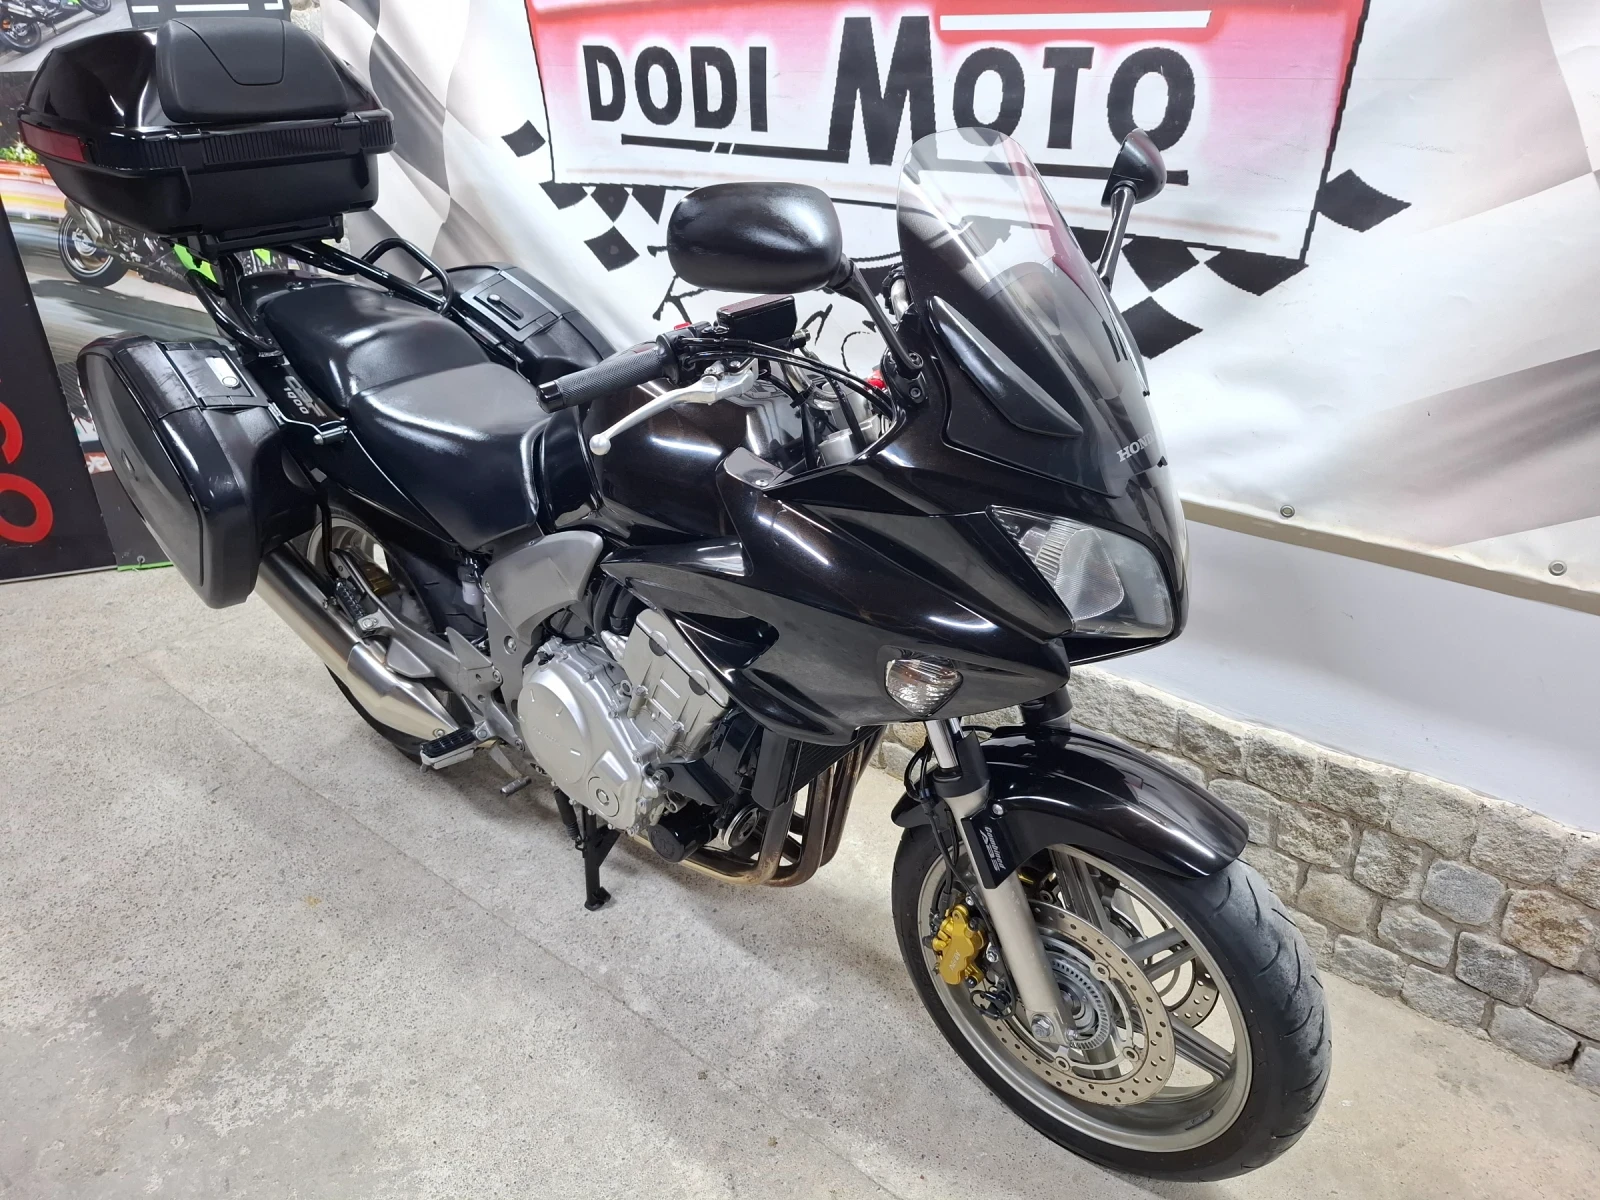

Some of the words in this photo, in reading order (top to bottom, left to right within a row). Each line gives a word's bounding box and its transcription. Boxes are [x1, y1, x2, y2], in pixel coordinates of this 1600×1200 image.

[583, 45, 768, 132] DODI
[828, 16, 1195, 166] MOTO
[283, 387, 310, 415] 1000
[1116, 432, 1154, 462] HOND
[984, 826, 1007, 870] Combined
